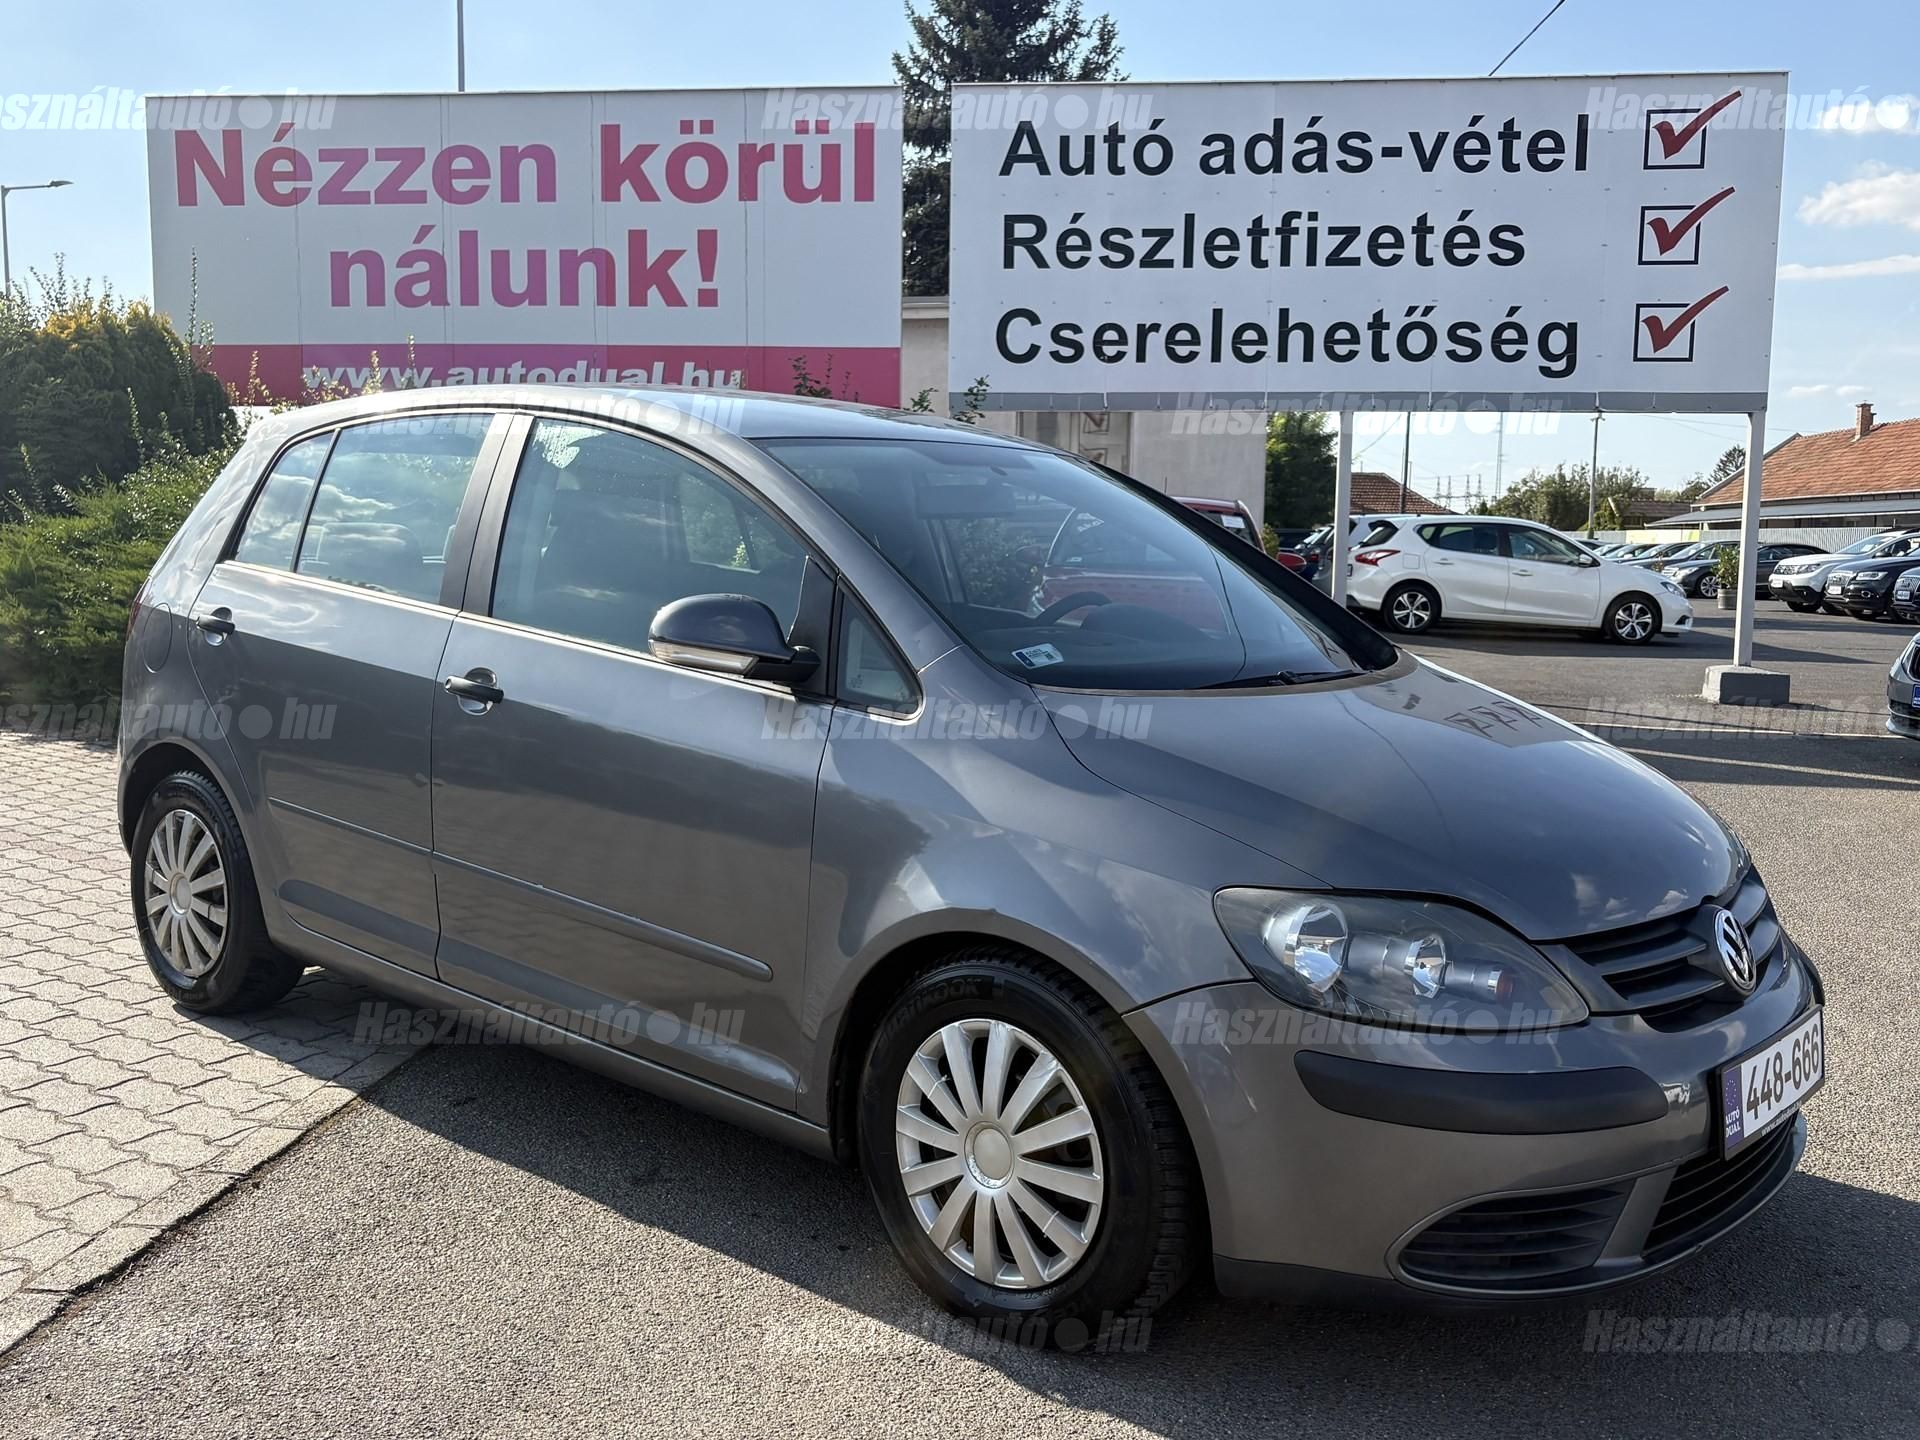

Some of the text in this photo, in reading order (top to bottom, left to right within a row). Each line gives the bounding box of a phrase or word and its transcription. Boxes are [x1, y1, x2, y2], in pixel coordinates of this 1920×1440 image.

[174, 119, 877, 208] Nézzen körül
[998, 112, 1590, 177] Autó adás-vétel
[330, 226, 720, 308] nálunk!
[1002, 208, 1526, 271] Részletfizetés
[996, 304, 1580, 379] Cserelehetőség
[1746, 1023, 1820, 1120] 448-666
